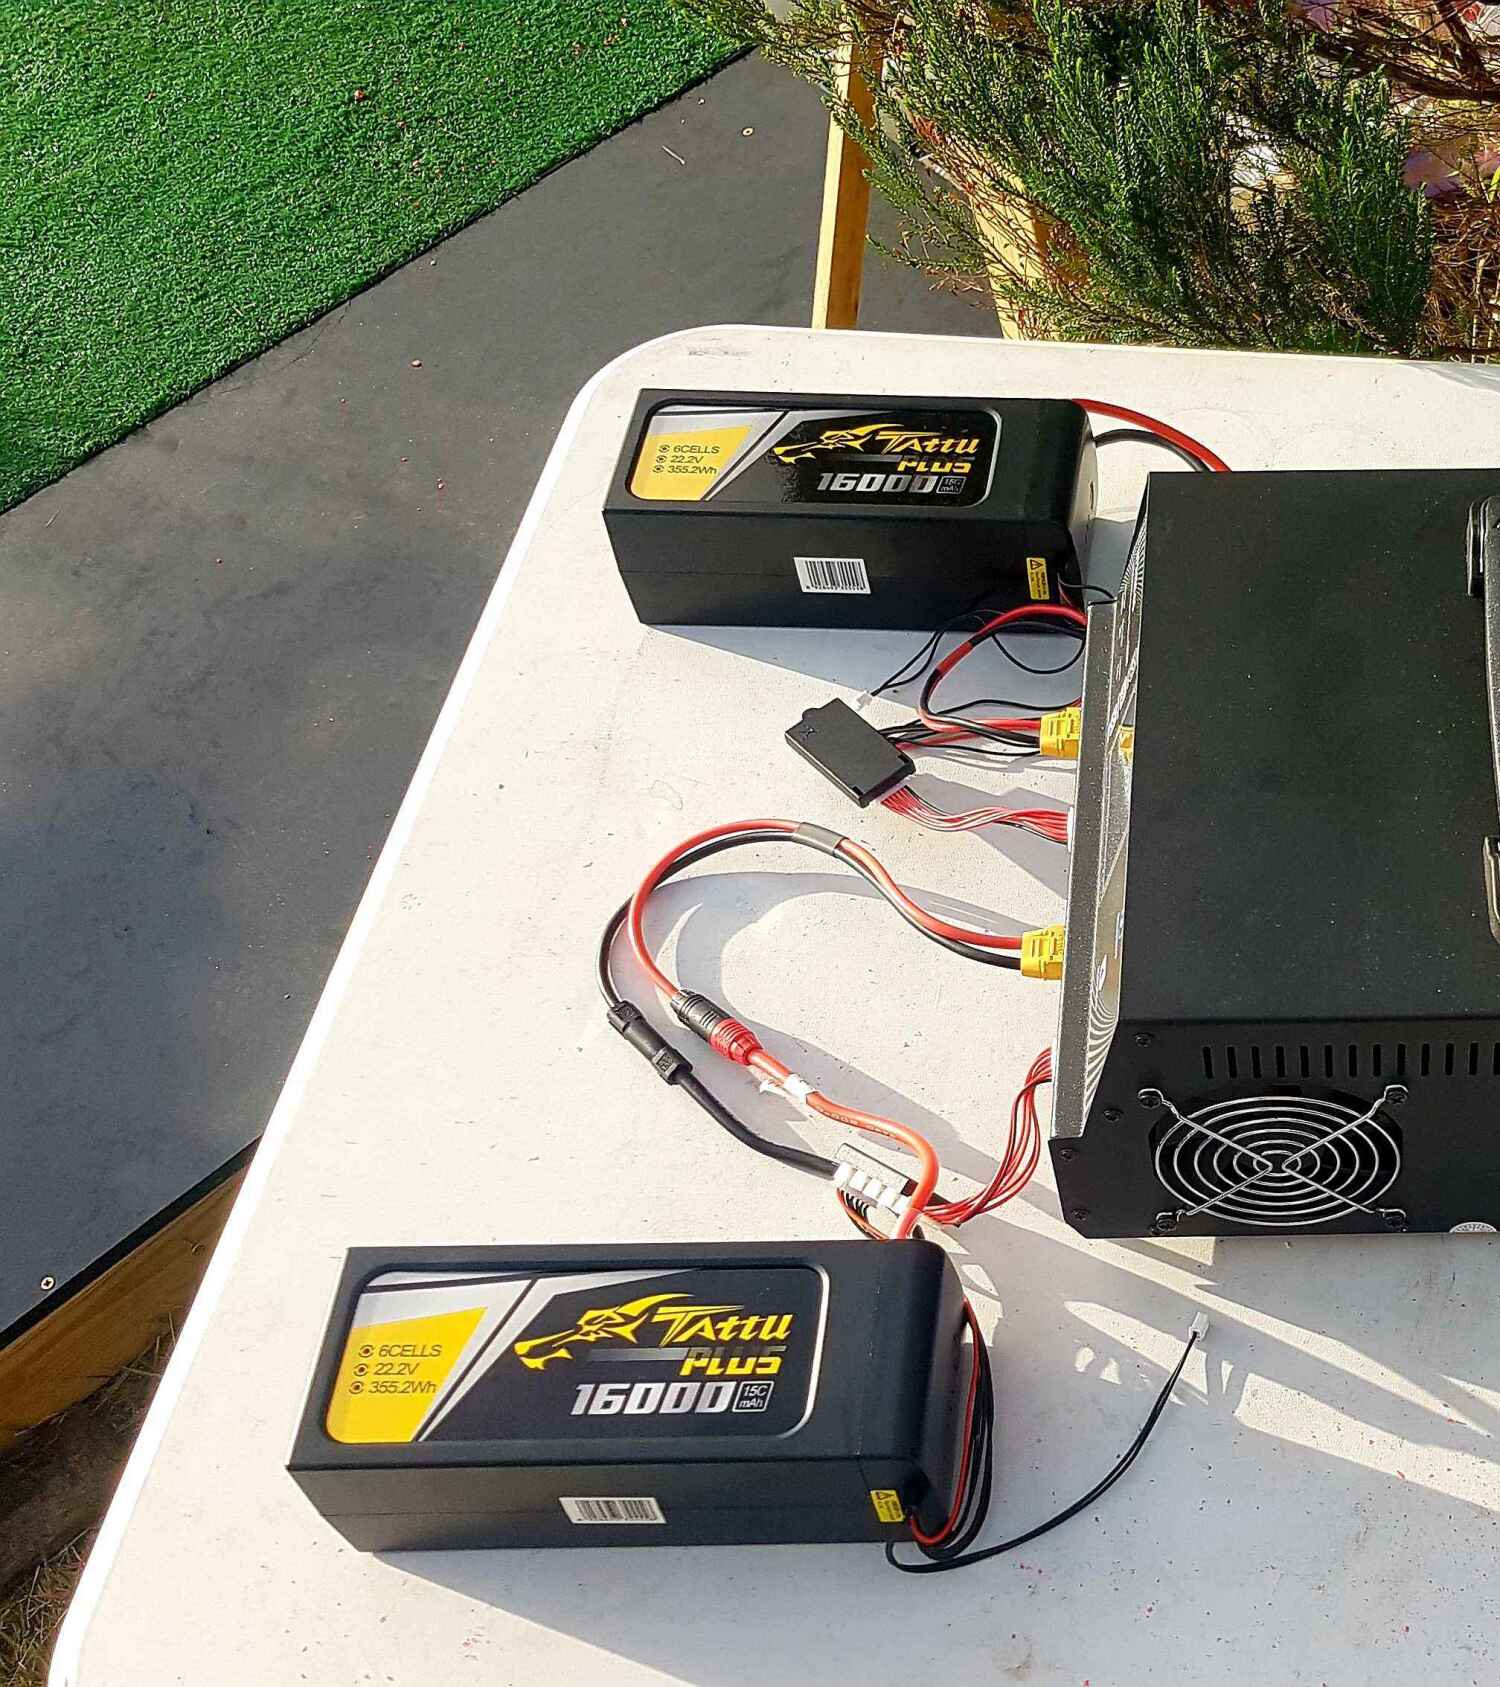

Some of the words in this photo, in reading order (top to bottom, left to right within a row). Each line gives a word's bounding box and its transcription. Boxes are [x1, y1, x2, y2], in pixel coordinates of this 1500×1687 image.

[673, 445, 720, 453] 6CELLS
[670, 455, 704, 463] 22.2V
[817, 472, 938, 493] 16000
[379, 1344, 442, 1357] 6CELLS
[680, 1347, 788, 1376] PLUS
[374, 1362, 419, 1375] 22.2V
[368, 1380, 437, 1394] 355.2Wh
[743, 1385, 767, 1397] 15C
[571, 1381, 737, 1415] 16000
[738, 1399, 763, 1408] mAh
